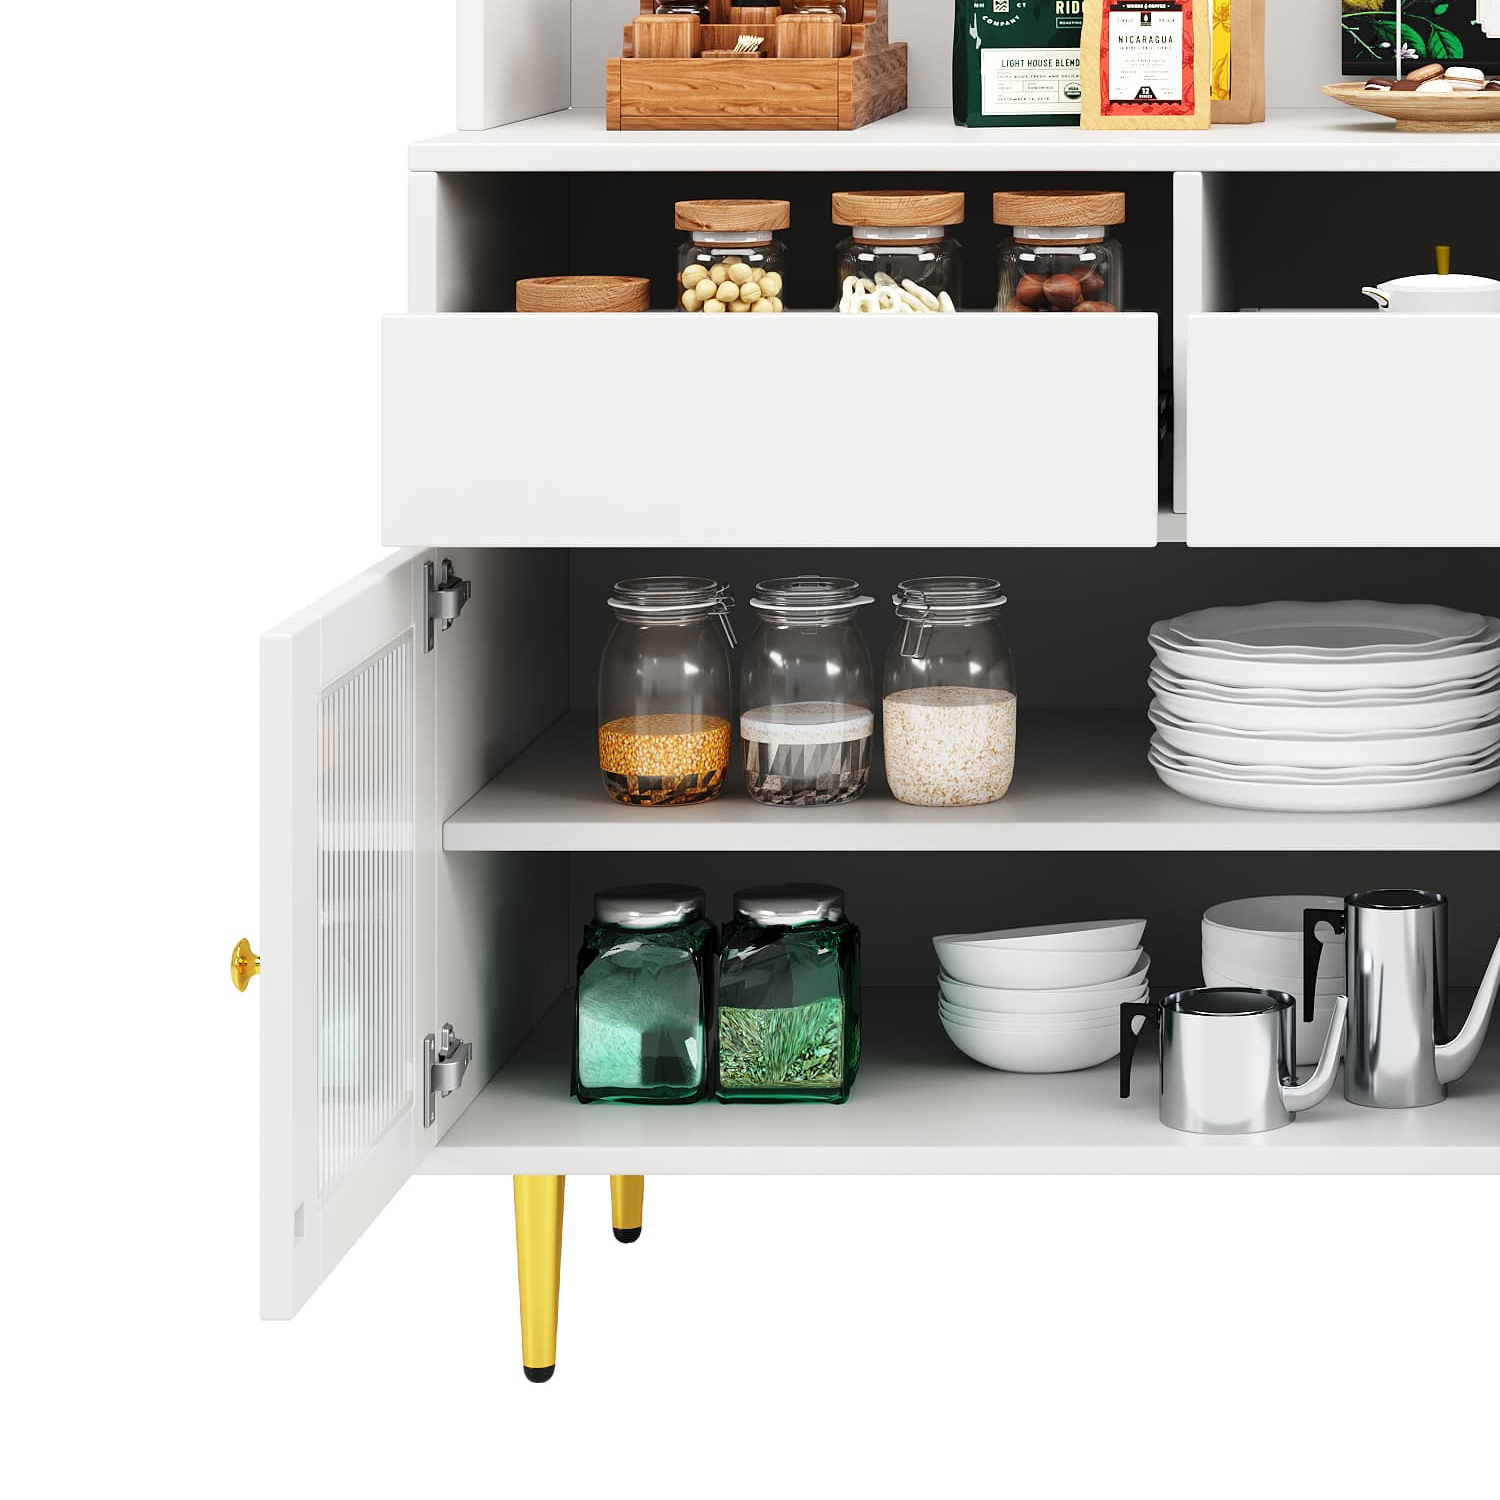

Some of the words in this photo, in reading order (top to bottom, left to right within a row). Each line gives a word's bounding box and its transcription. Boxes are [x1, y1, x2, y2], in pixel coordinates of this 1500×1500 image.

[1056, 0, 1084, 14] RID
[982, 14, 1020, 27] COMPANY
[1118, 35, 1173, 44] NICARAGUA
[1001, 59, 1024, 68] LIGHT
[1027, 59, 1052, 67] HOUSE
[1055, 58, 1080, 67] BLEND
